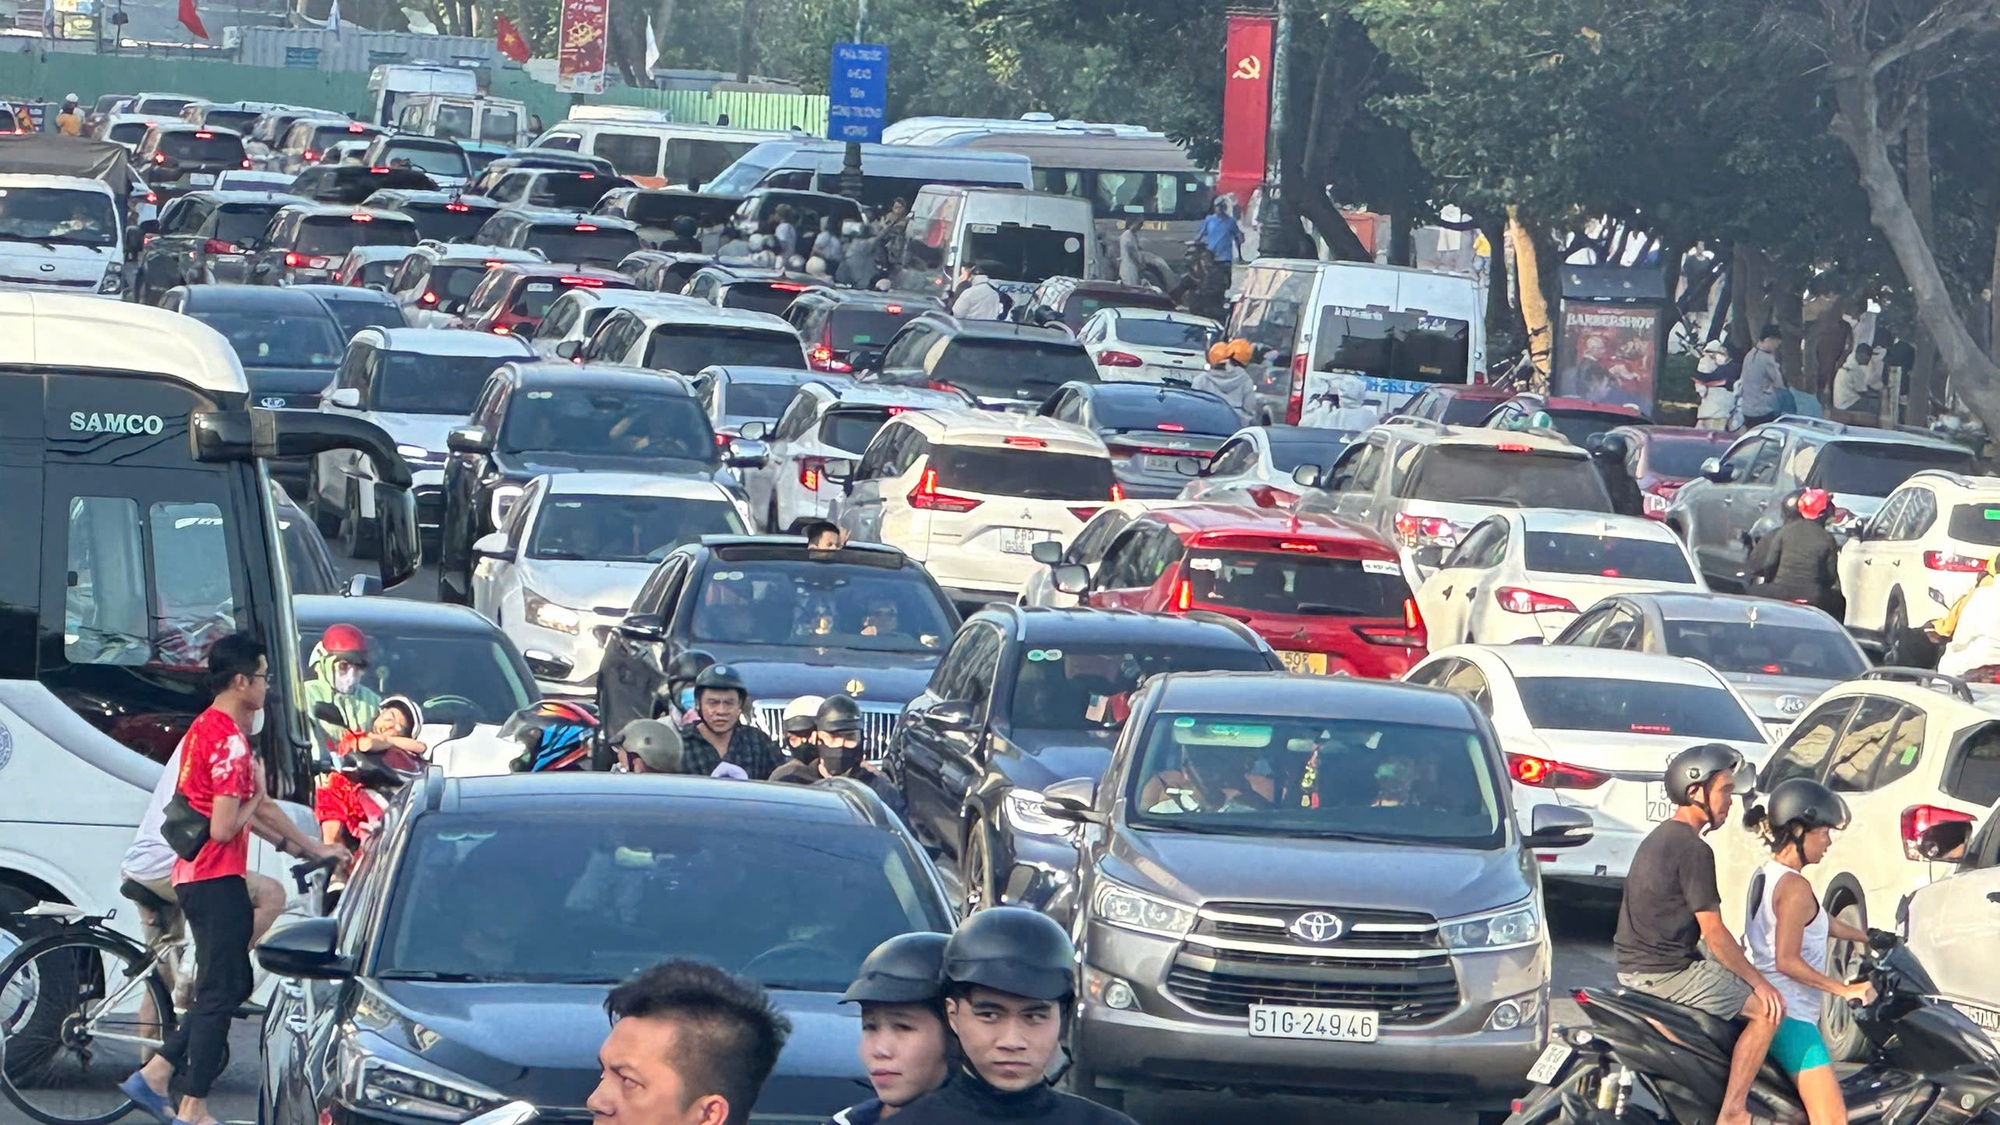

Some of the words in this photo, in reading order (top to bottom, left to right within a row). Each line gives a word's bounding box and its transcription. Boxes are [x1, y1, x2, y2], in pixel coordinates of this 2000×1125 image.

[1566, 313, 1655, 330] BARBERSHOP
[70, 411, 164, 435] SAMCO
[1254, 1009, 1373, 1038] 51G-249.46
